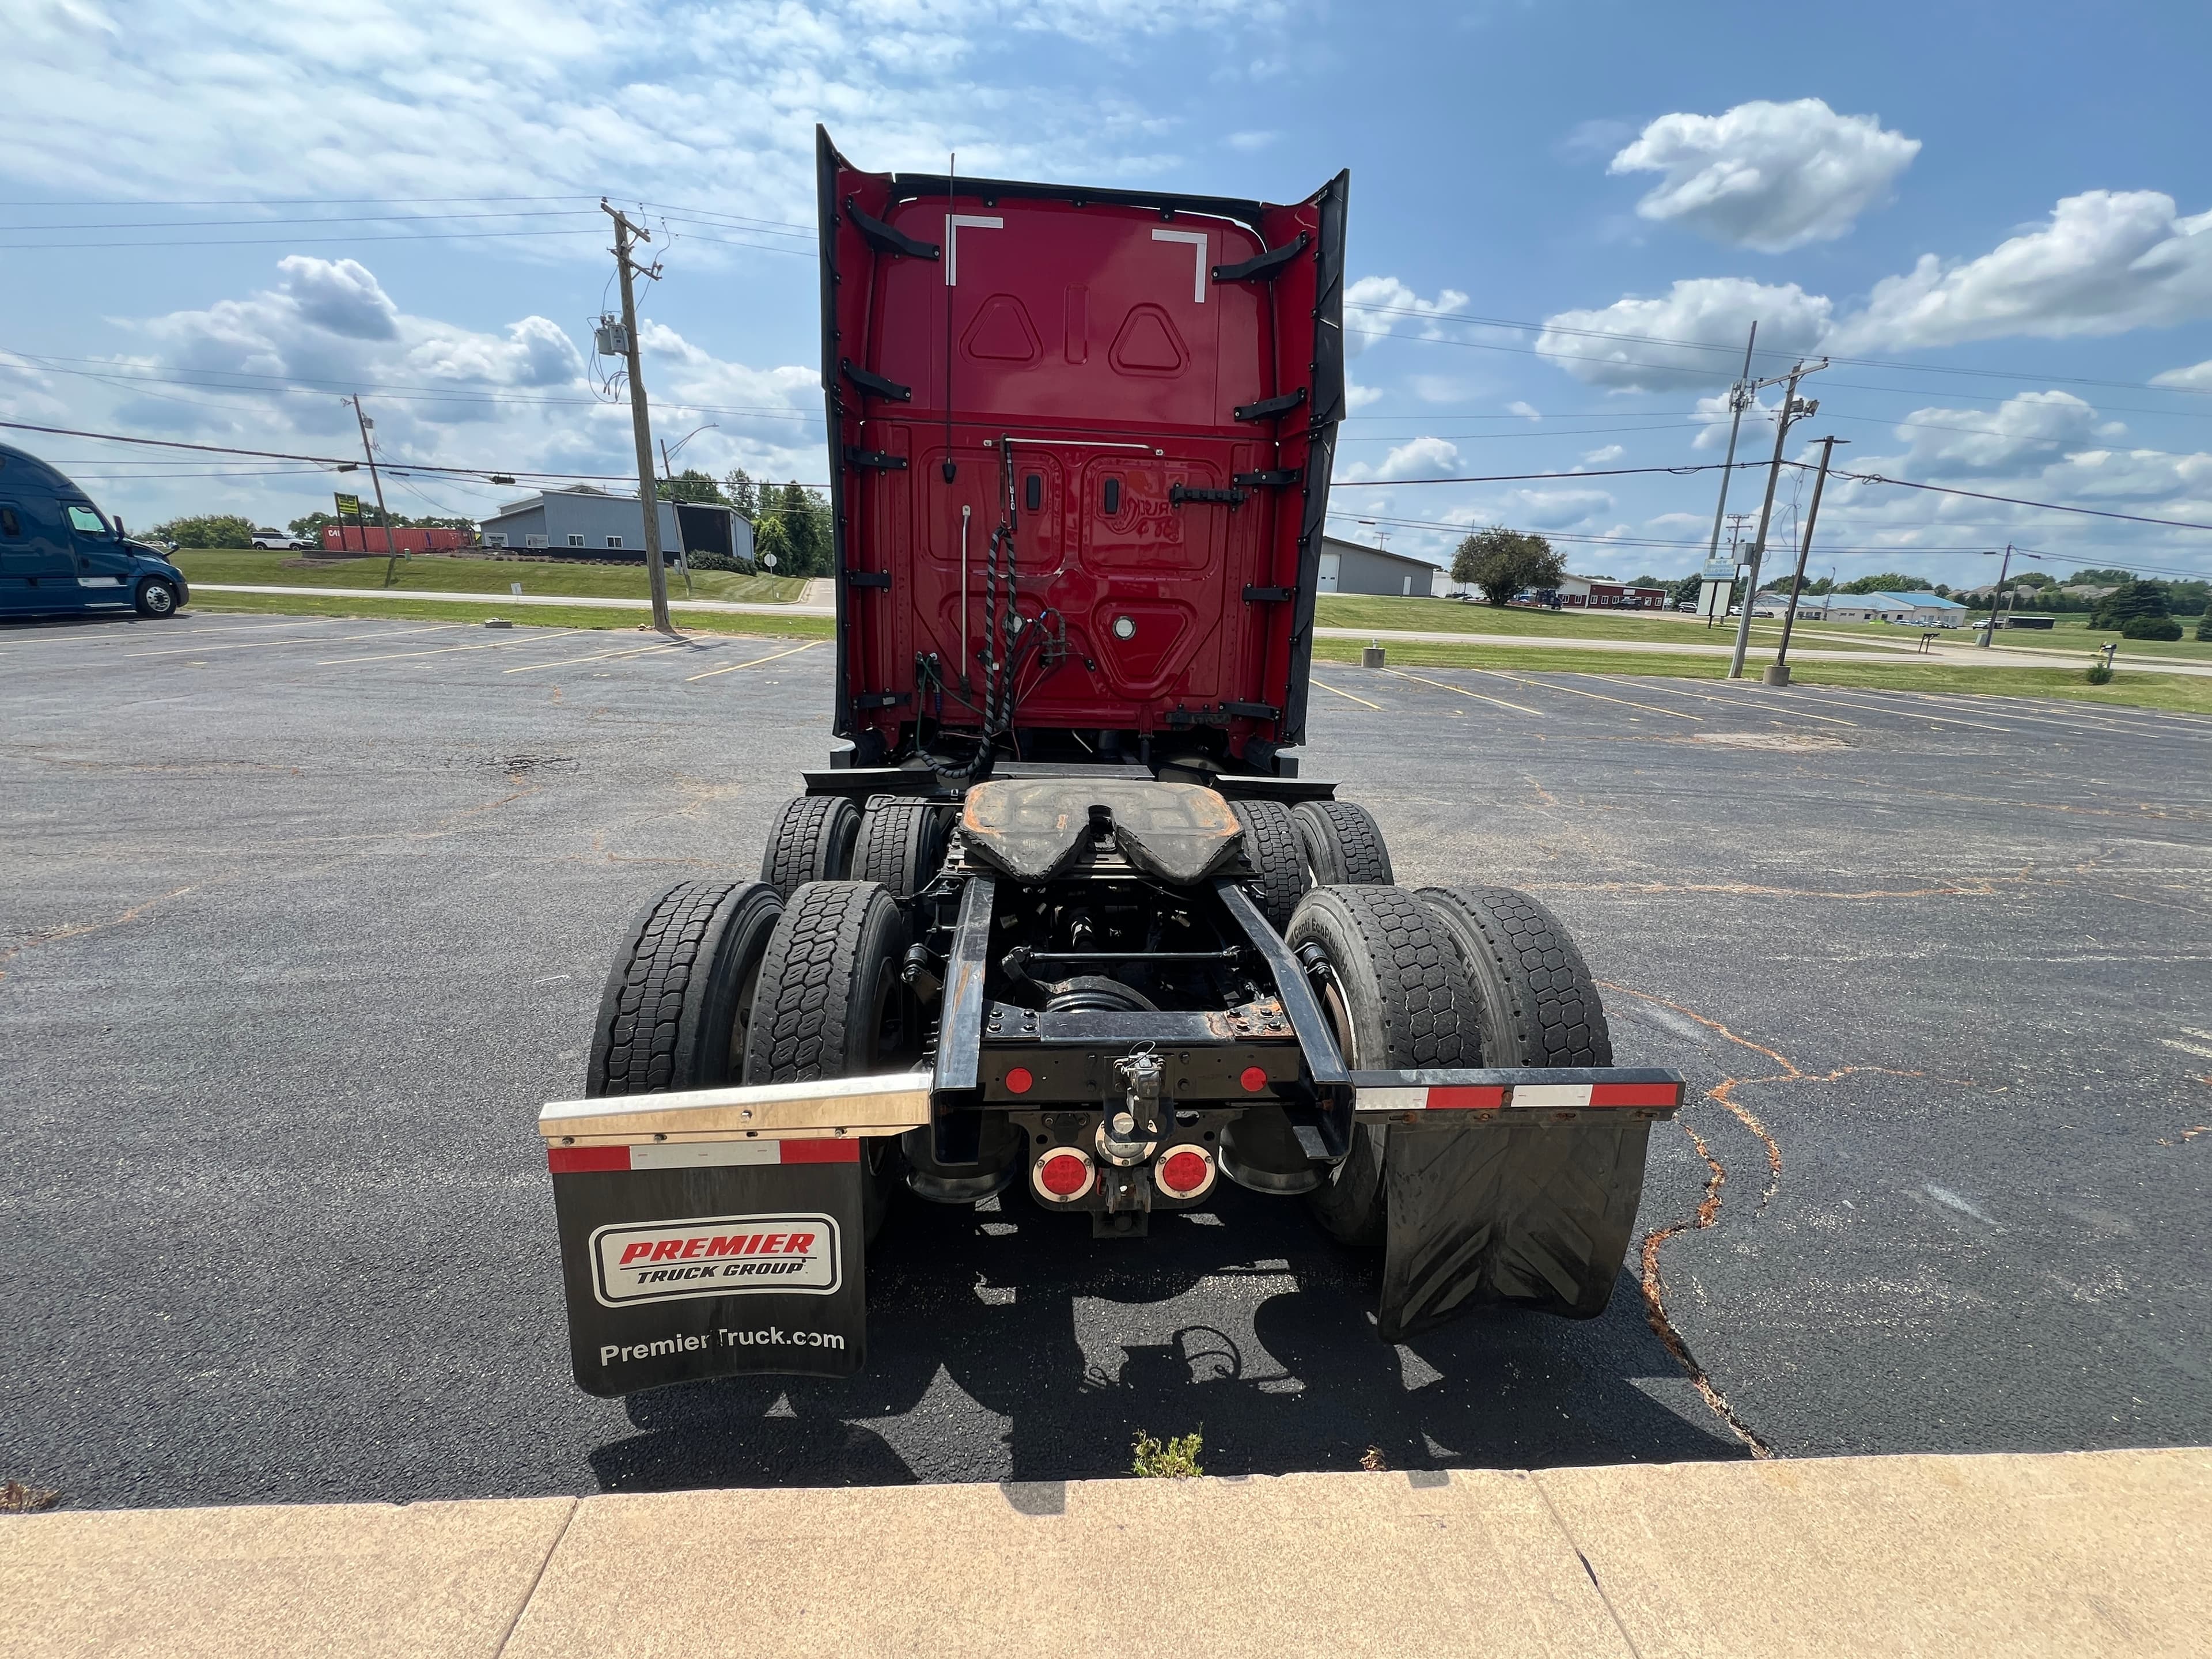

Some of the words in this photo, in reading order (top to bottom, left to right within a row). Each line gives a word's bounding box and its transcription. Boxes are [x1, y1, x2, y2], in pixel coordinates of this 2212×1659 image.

[1294, 918, 1310, 940] Conti
[619, 1233, 816, 1265] PREMIER
[637, 1266, 719, 1285] TRUCK
[722, 1262, 804, 1277] GROUP
